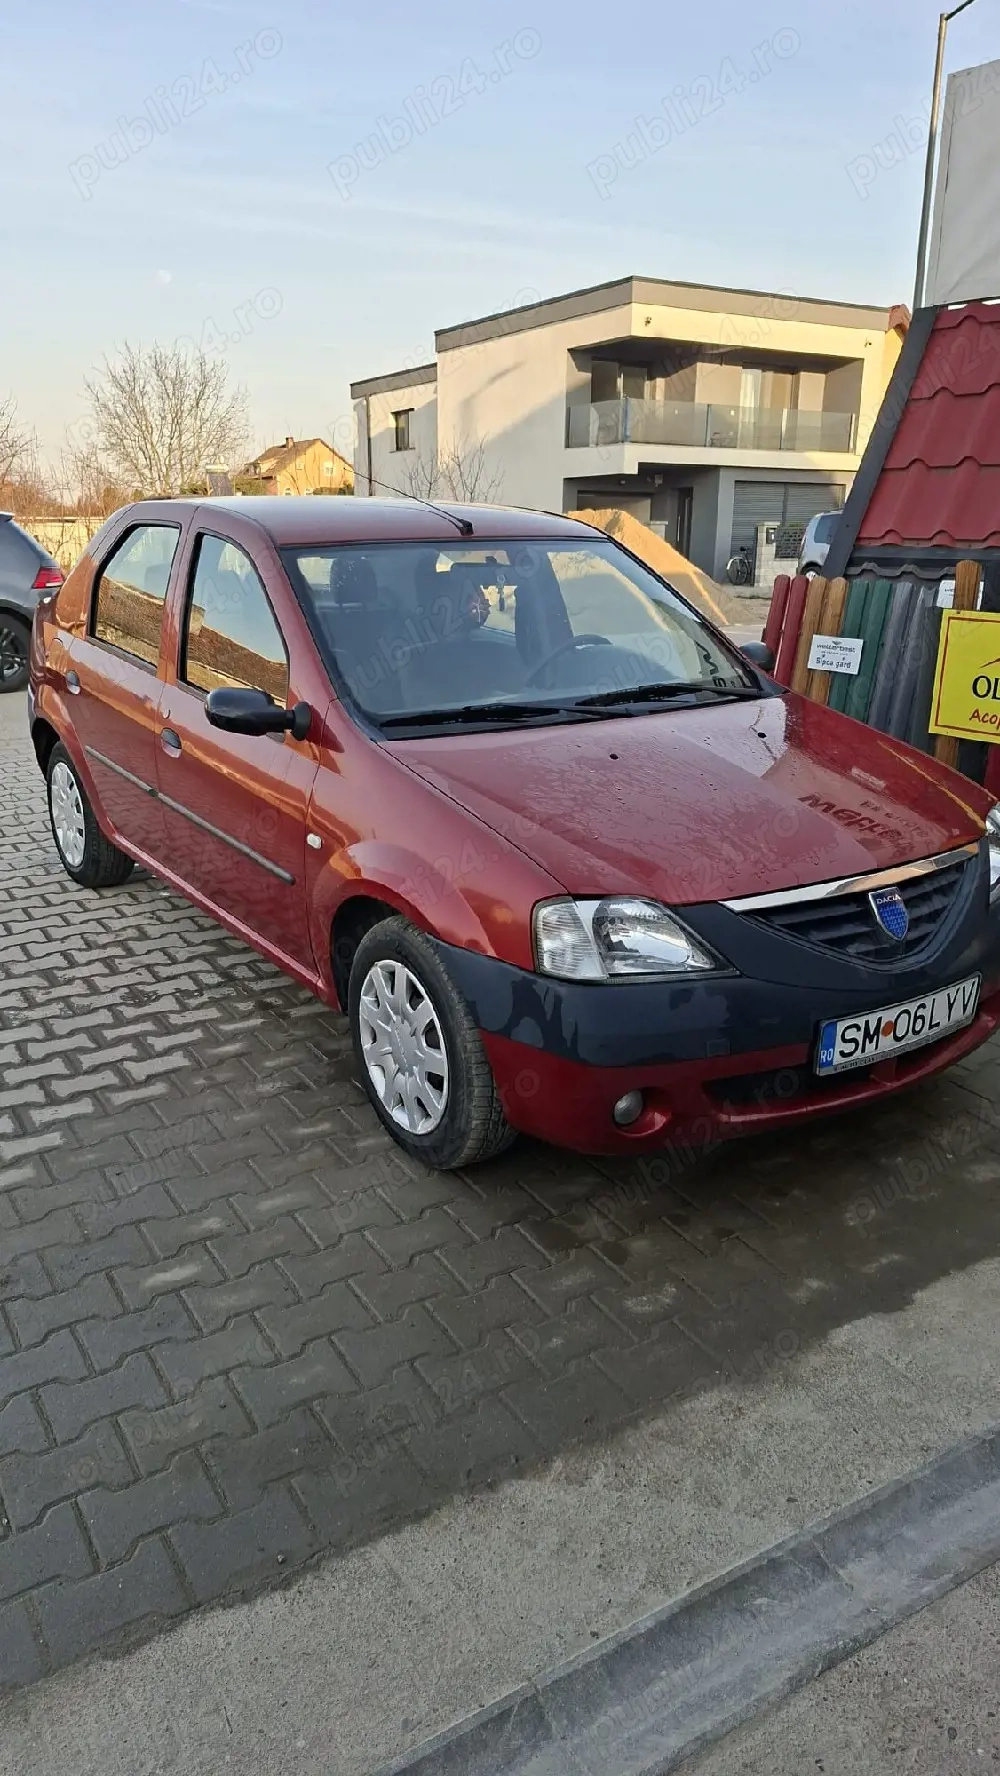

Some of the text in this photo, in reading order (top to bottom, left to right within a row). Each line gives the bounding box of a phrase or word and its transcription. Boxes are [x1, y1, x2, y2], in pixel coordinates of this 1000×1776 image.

[876, 893, 901, 905] DACIA
[839, 1016, 883, 1059] SM
[820, 1048, 834, 1064] RO
